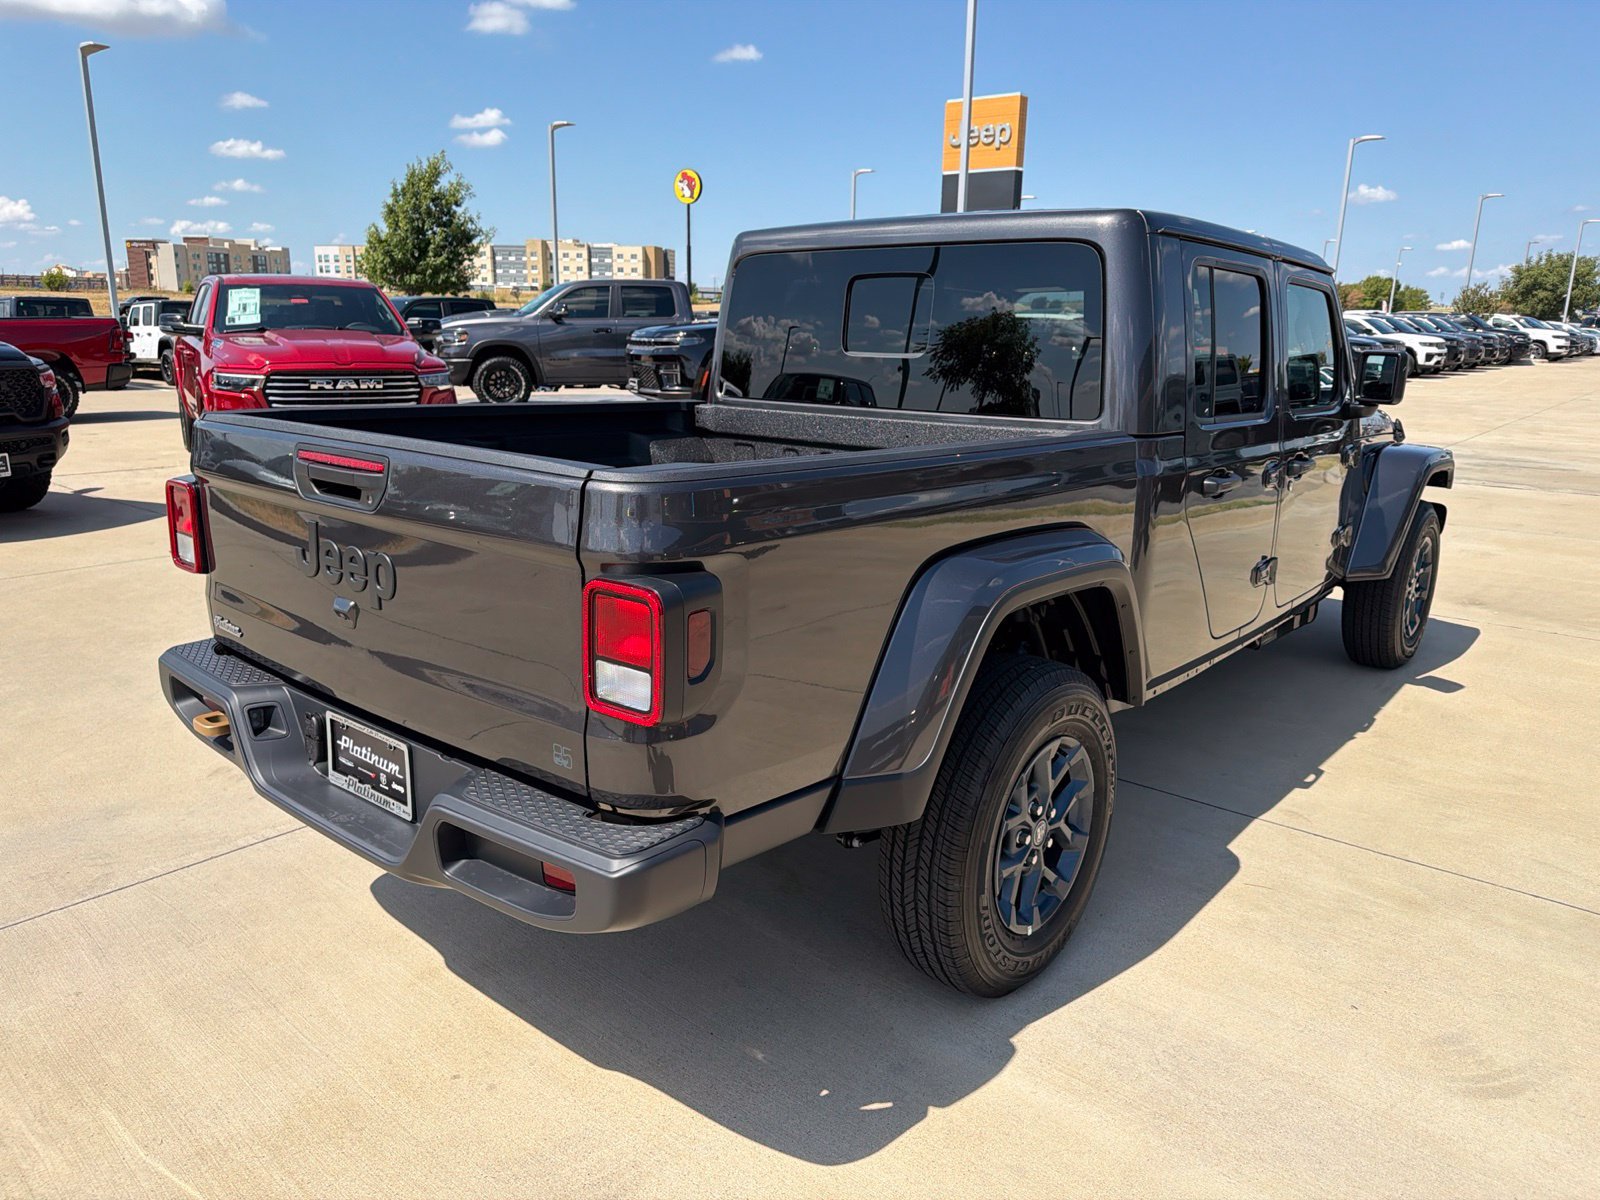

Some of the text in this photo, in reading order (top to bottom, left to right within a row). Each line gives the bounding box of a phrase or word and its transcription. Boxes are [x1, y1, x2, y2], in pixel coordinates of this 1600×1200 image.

[309, 378, 384, 390] RAM
[295, 520, 397, 610] Jeep
[336, 735, 404, 779] Platinum
[346, 777, 395, 811] Platinum
